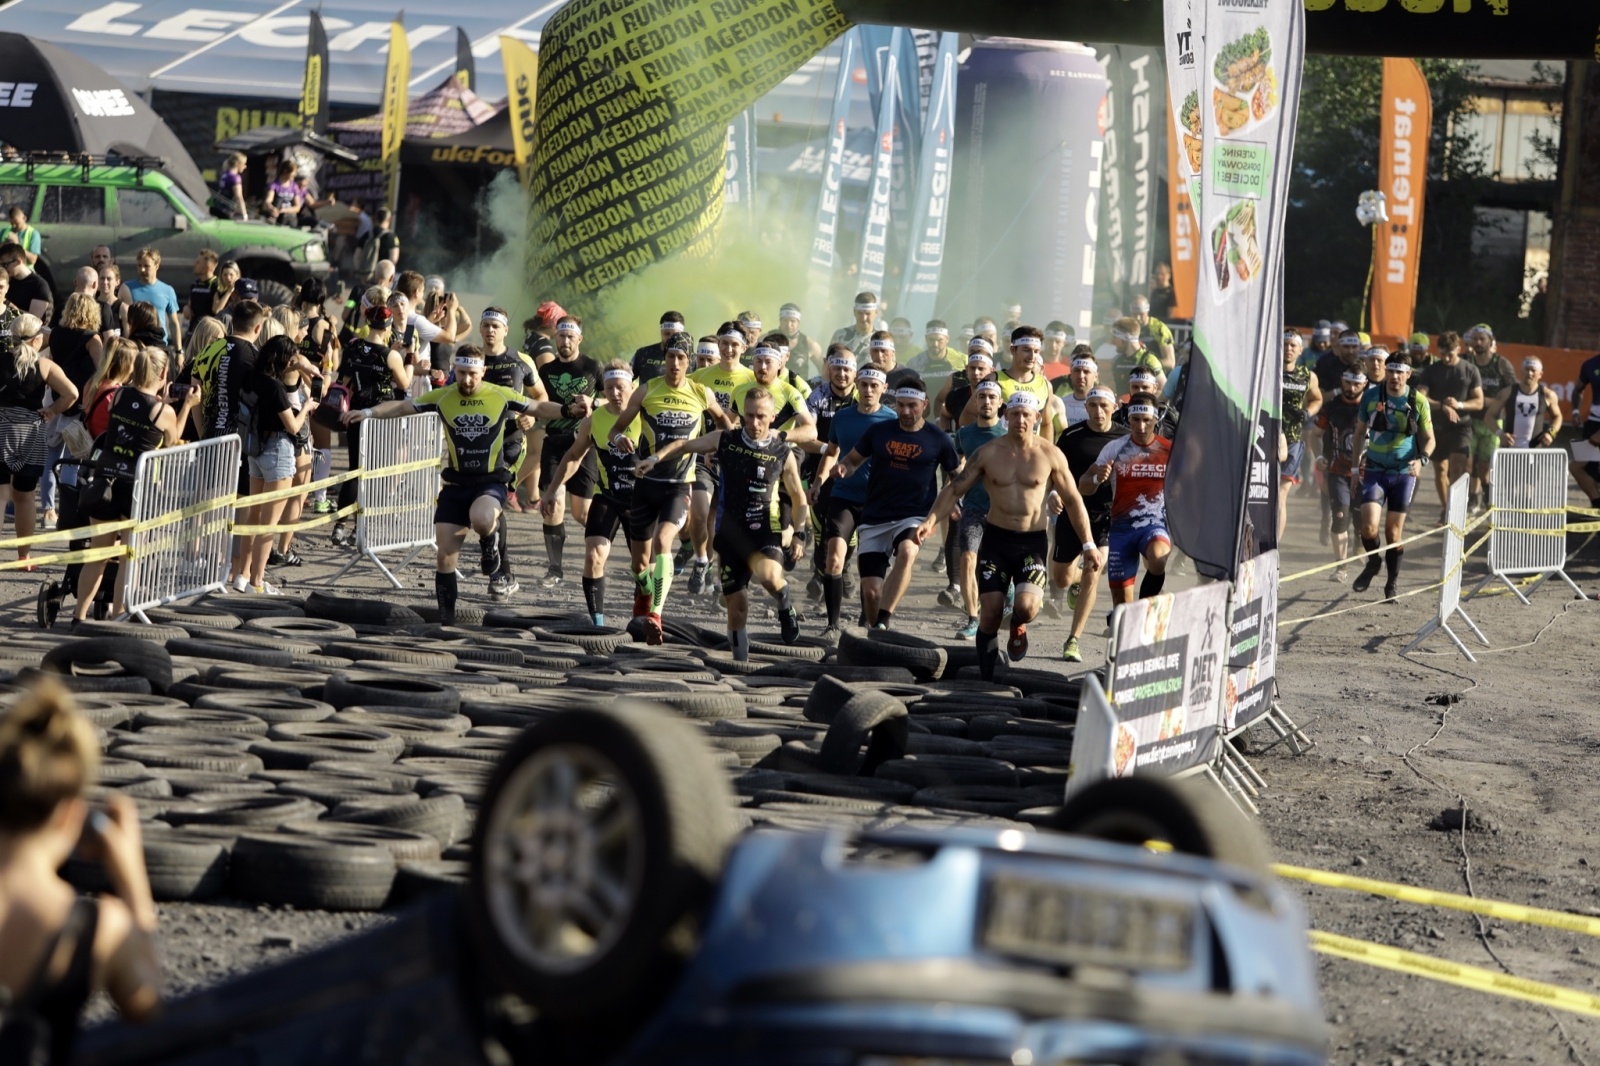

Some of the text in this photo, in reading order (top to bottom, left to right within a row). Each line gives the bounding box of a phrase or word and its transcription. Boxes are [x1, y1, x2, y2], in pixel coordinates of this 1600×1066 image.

[549, 102, 672, 181] RUNMAGEDDON
[562, 145, 690, 224] RUNMAGEDDON
[818, 137, 844, 236] LECH
[866, 152, 891, 246] LECH
[578, 189, 703, 267] RUNMAGEDDON
[890, 440, 918, 451] BEAST
